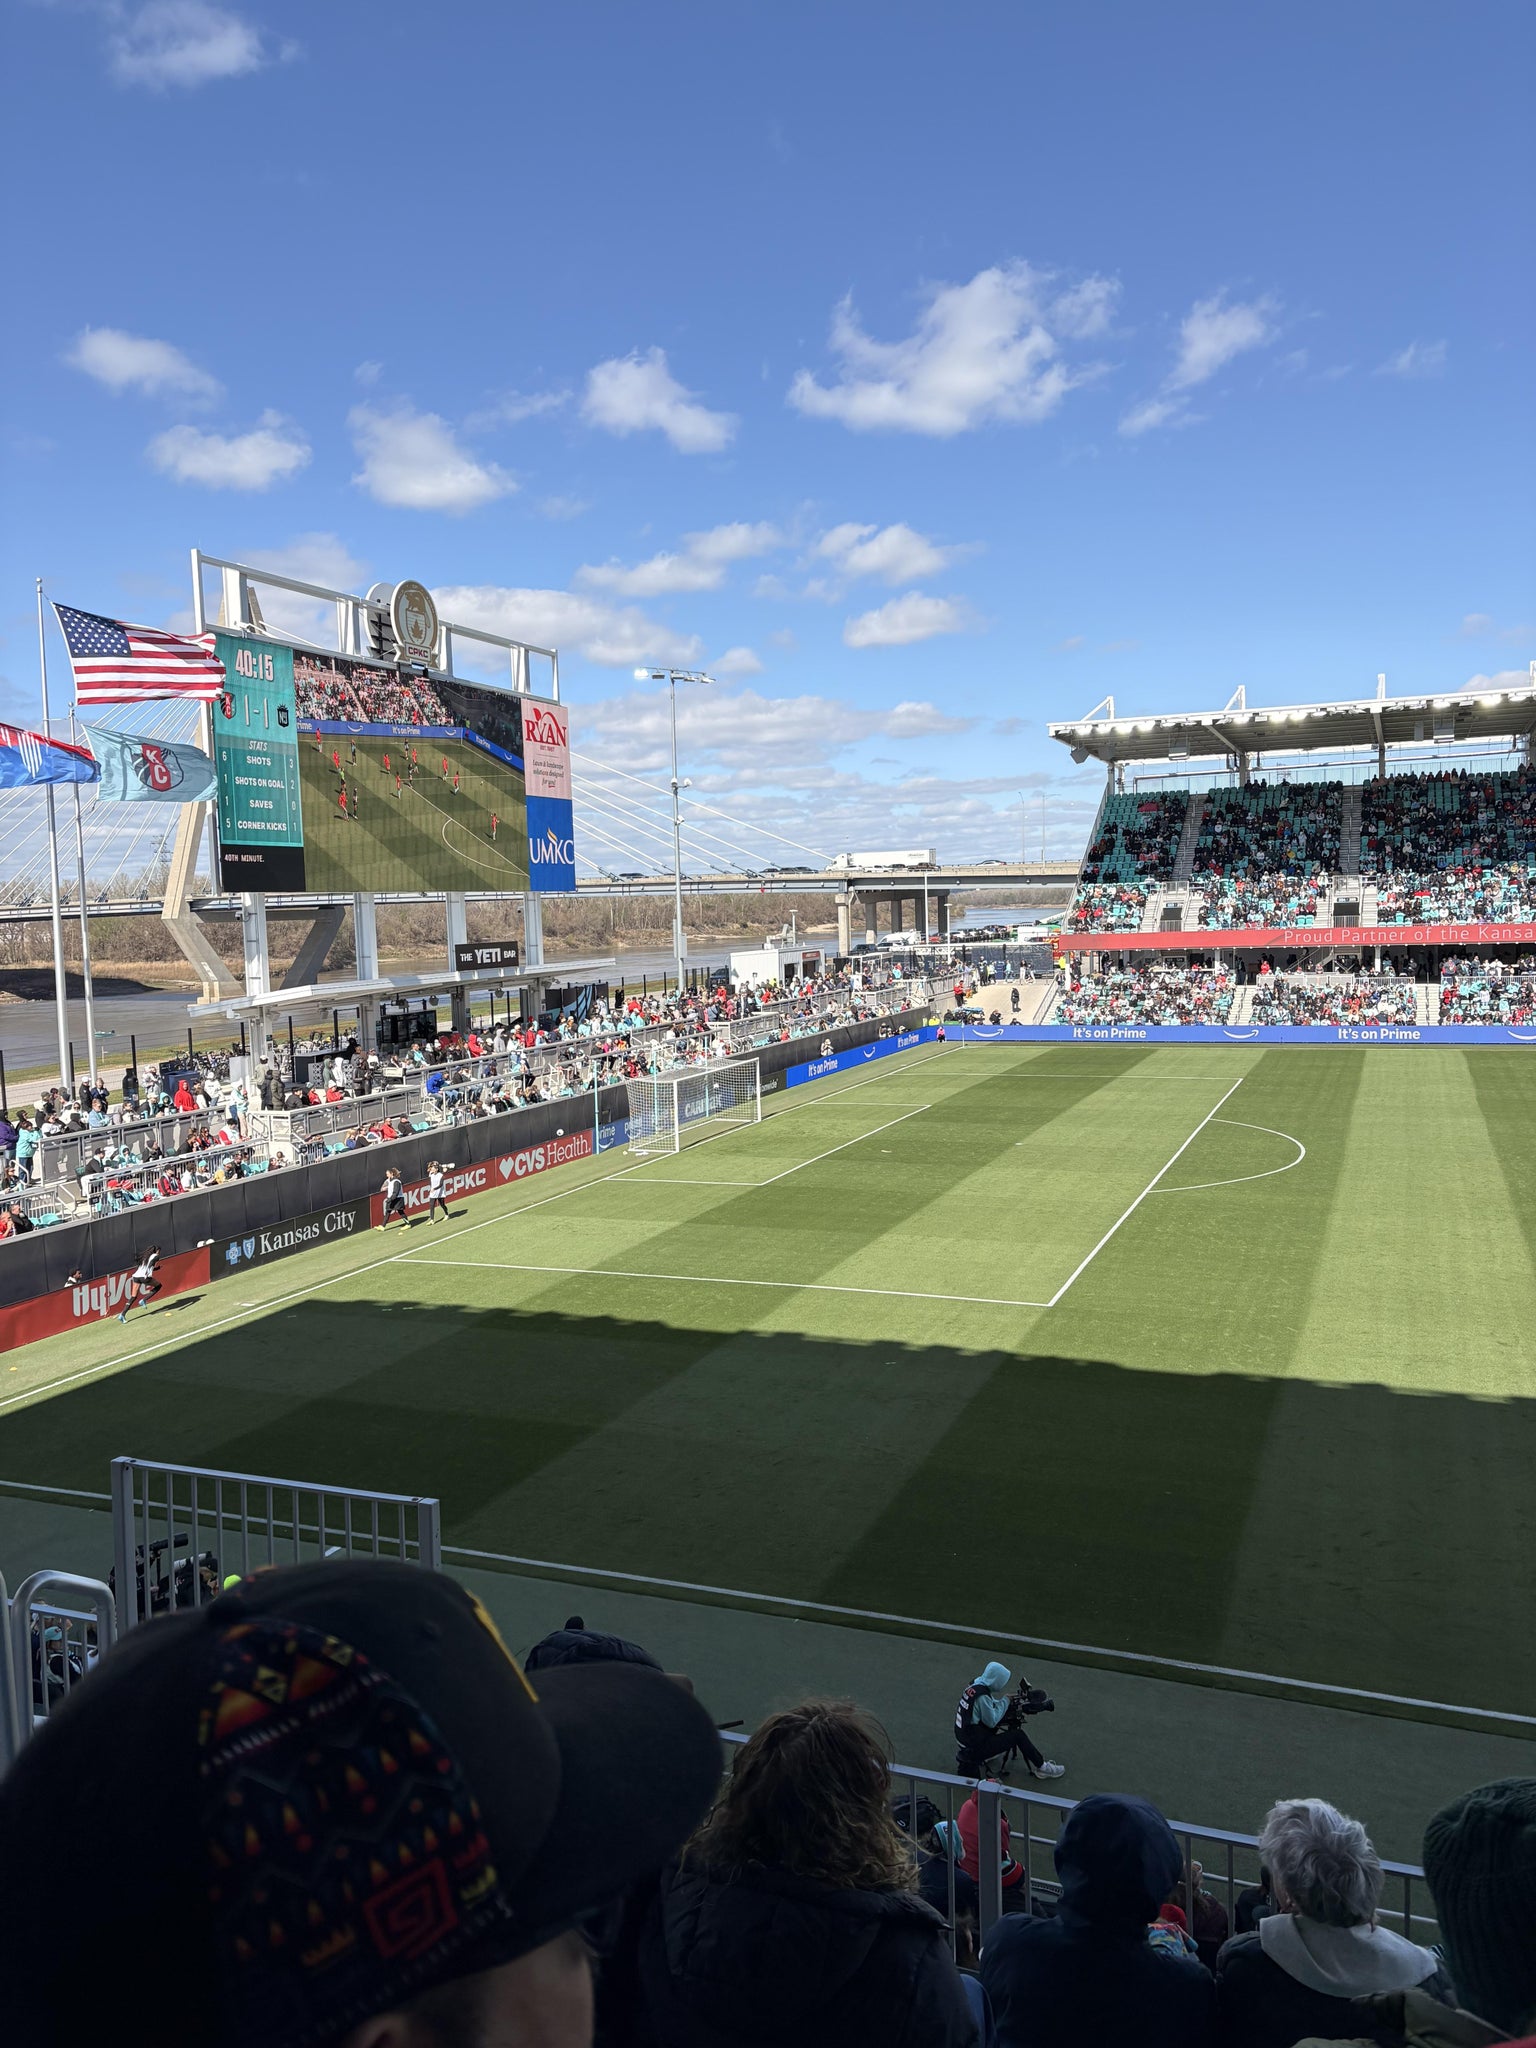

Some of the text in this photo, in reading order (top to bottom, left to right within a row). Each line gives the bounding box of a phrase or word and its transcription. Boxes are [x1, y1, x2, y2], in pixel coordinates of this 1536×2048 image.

[408, 646, 428, 658] CPKC
[236, 649, 274, 681] 40:15
[407, 727, 420, 736] Prime
[525, 711, 567, 747] RYAN
[248, 740, 268, 752] STATS
[222, 751, 228, 762] 6
[246, 755, 272, 767] SHOTS
[289, 759, 294, 769] 3
[224, 774, 228, 783] 1
[235, 776, 285, 789] SHOTS ON GOAL
[291, 780, 295, 789] 2
[225, 796, 229, 806] 1
[249, 799, 274, 809] SAVES
[292, 801, 296, 811] 0
[226, 818, 231, 828] 5
[237, 820, 287, 832] CORNER KICKS
[293, 822, 297, 831] 1
[529, 837, 575, 865] UMKC
[224, 854, 265, 863] 40TH MINUTE.
[1284, 925, 1533, 943] Proud Partner of the Kansa
[460, 947, 517, 964] THE YETI BAR
[1073, 1028, 1147, 1038] It's on Prime
[1338, 1028, 1421, 1040] It's on Prime
[904, 1037, 909, 1046] on
[908, 1033, 919, 1044] Prime
[808, 1058, 838, 1077] It's on Prime
[599, 1126, 616, 1140] rime
[515, 1148, 545, 1176] CVS
[443, 1168, 486, 1196] CPKC
[259, 1209, 357, 1256] Kansas City
